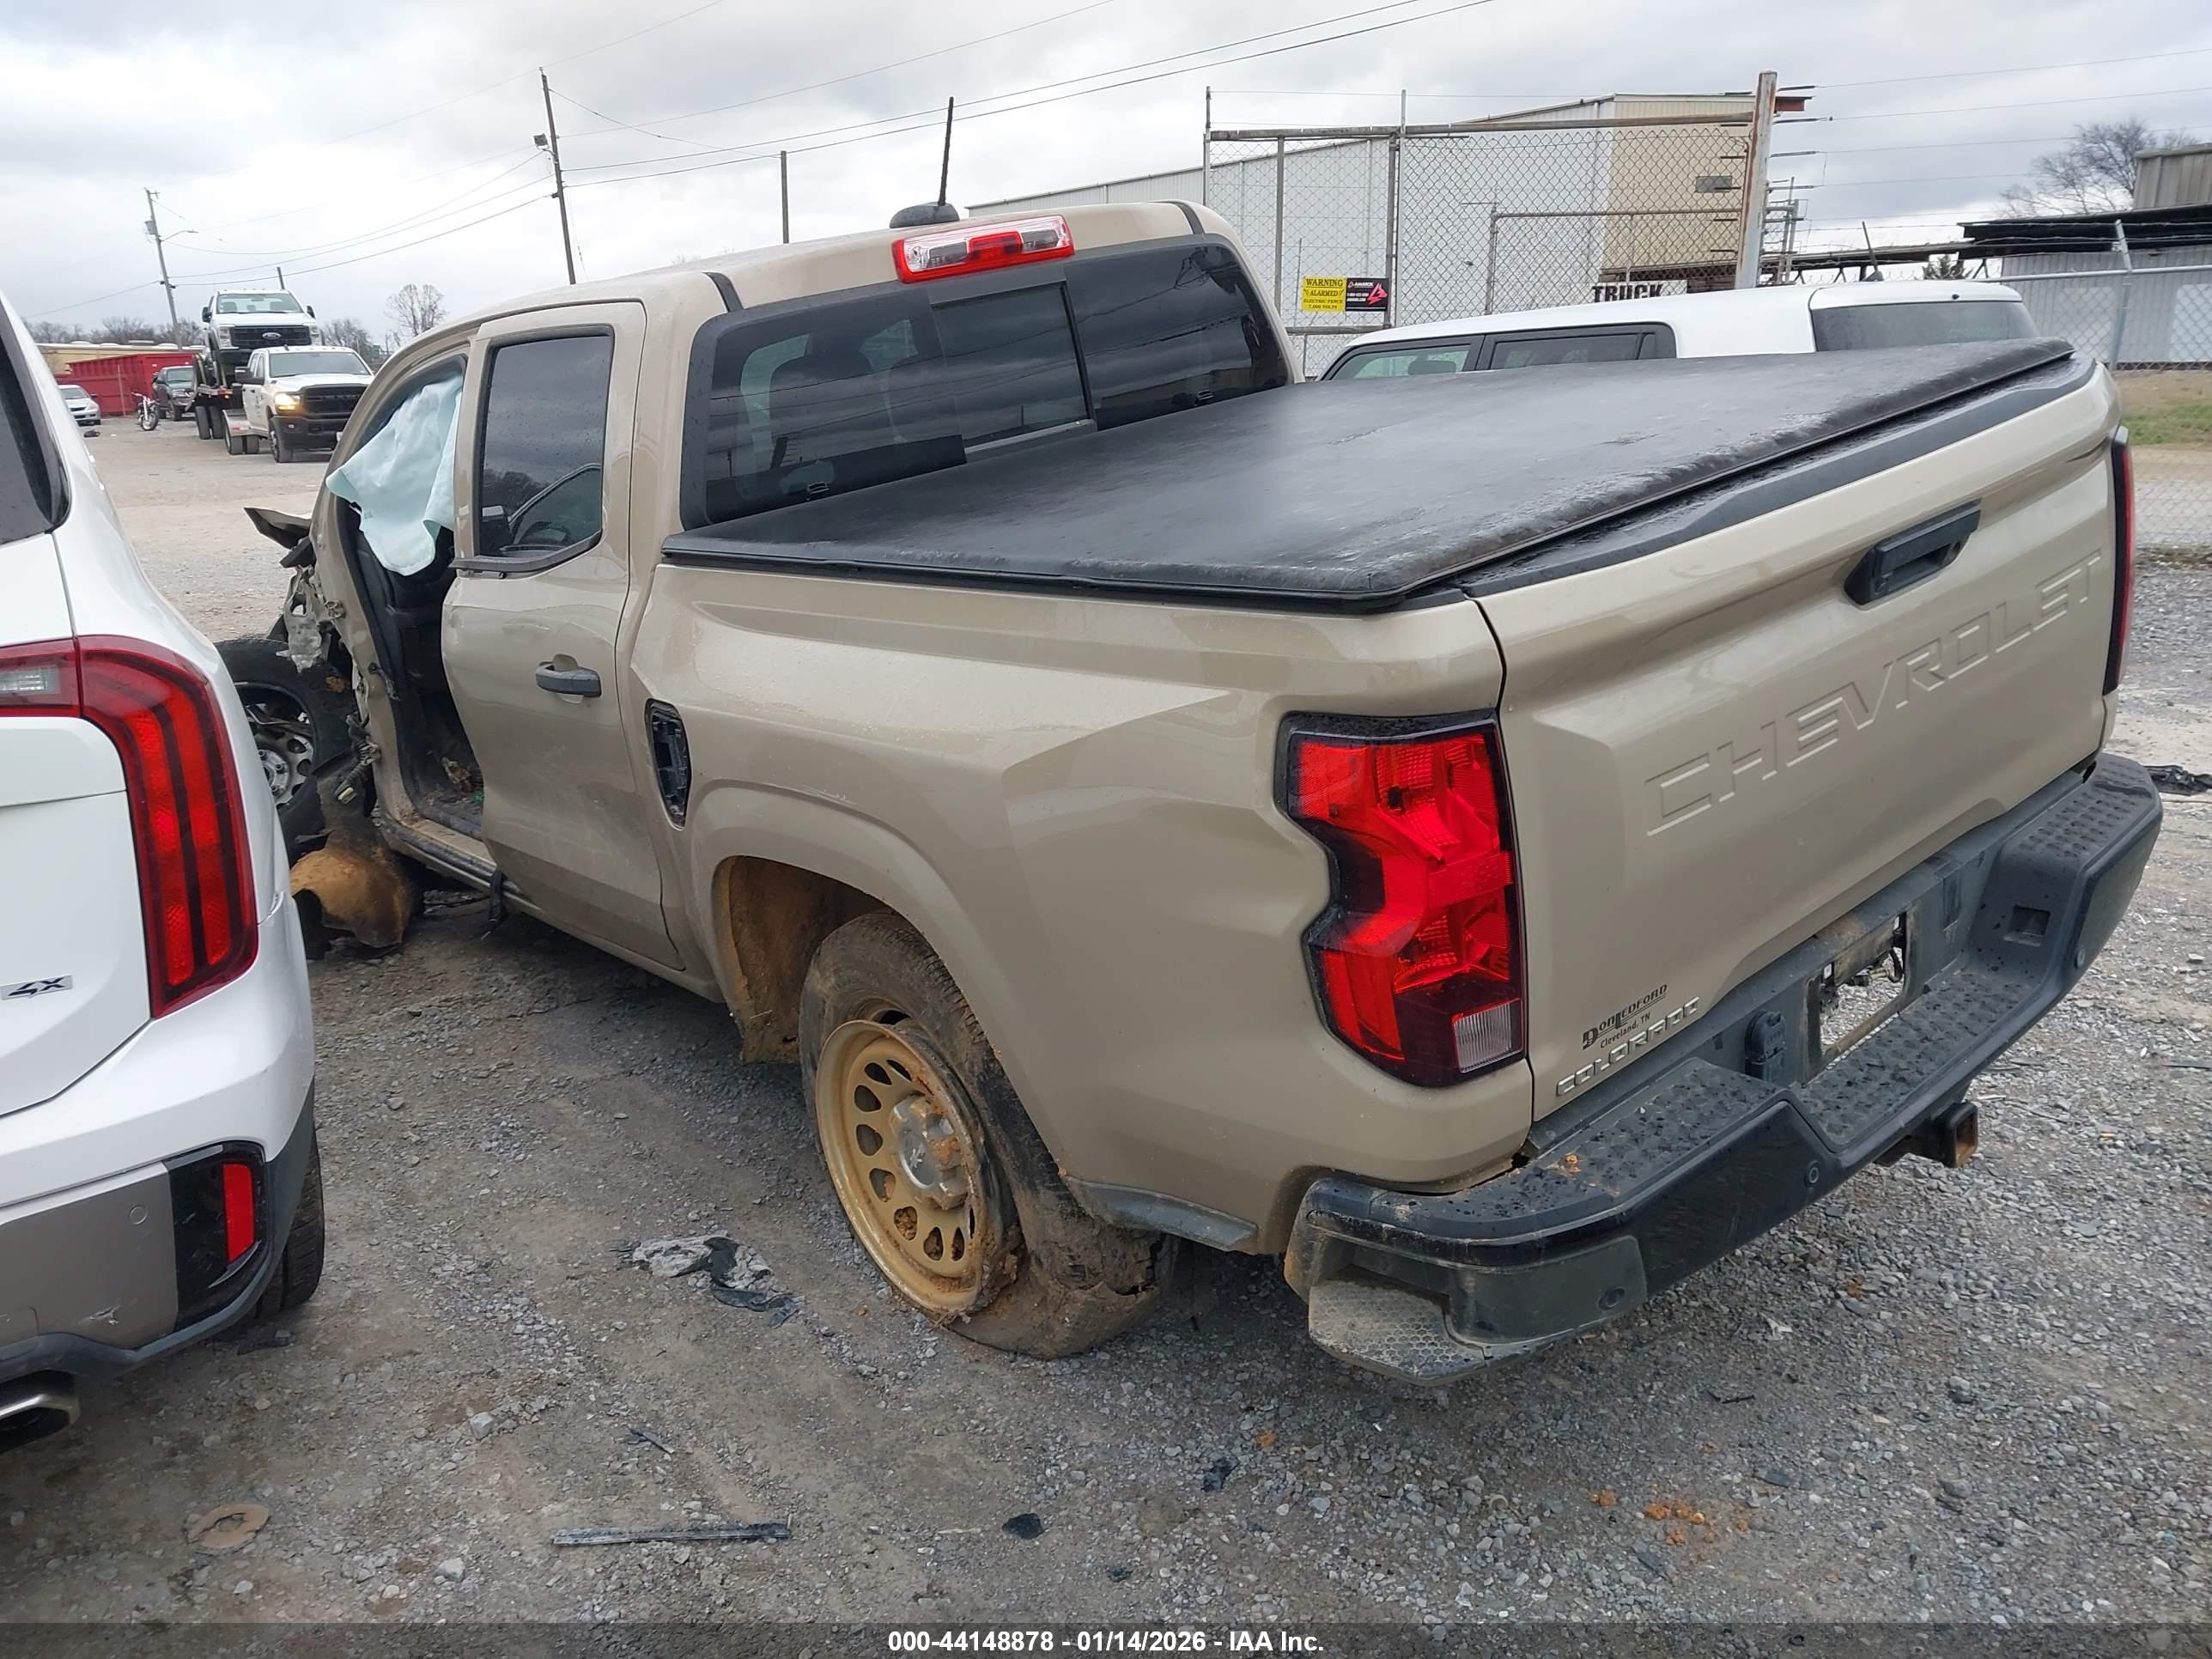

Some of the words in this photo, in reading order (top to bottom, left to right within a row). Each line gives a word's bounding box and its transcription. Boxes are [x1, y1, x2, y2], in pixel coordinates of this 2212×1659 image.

[1305, 278, 1343, 287] WARNING
[1592, 284, 1662, 302] TRUCK
[1644, 549, 2101, 836] CHEVROLET
[1556, 996, 1700, 1097] COLORADO
[1600, 1020, 1639, 1048] Cleveland,
[1640, 1012, 1650, 1024] TN
